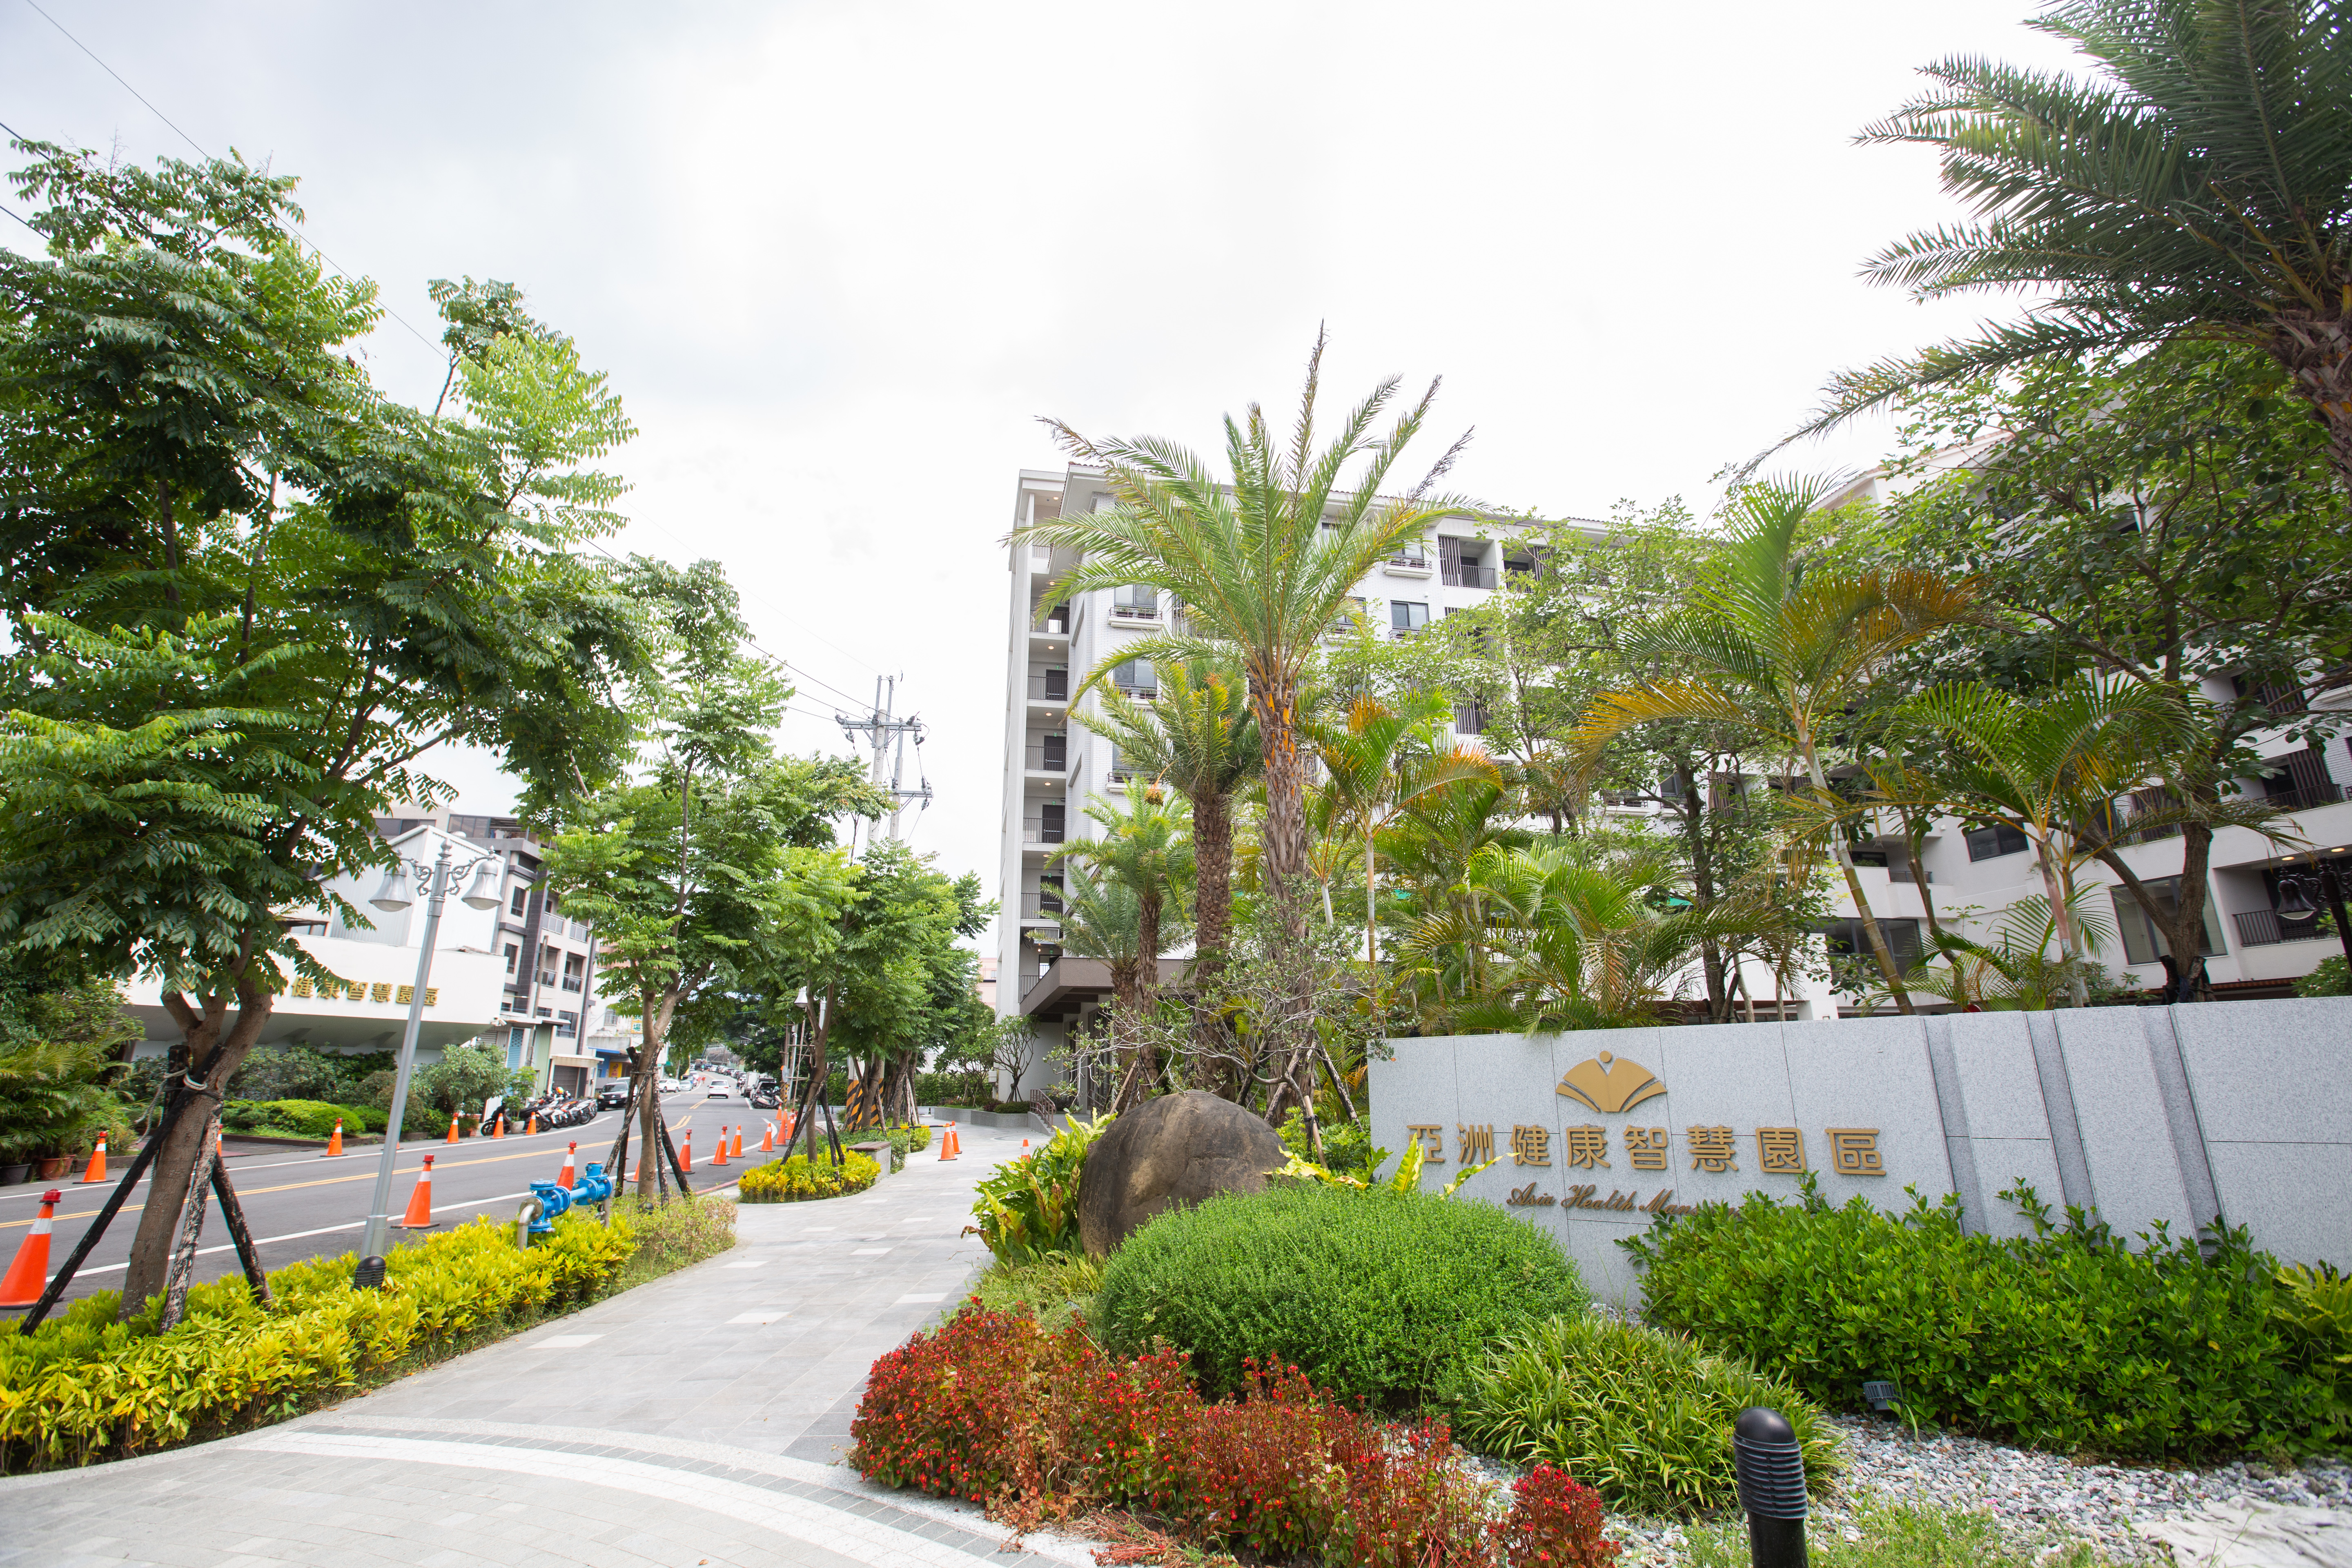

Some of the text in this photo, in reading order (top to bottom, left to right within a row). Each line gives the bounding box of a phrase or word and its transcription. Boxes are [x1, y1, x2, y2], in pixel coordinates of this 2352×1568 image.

[283, 976, 440, 1006] 健康智慧園區
[1406, 1123, 1886, 1176] 亞洲健康智慧園區
[1506, 1182, 1556, 1205] Asia
[1560, 1184, 1637, 1212] Health
